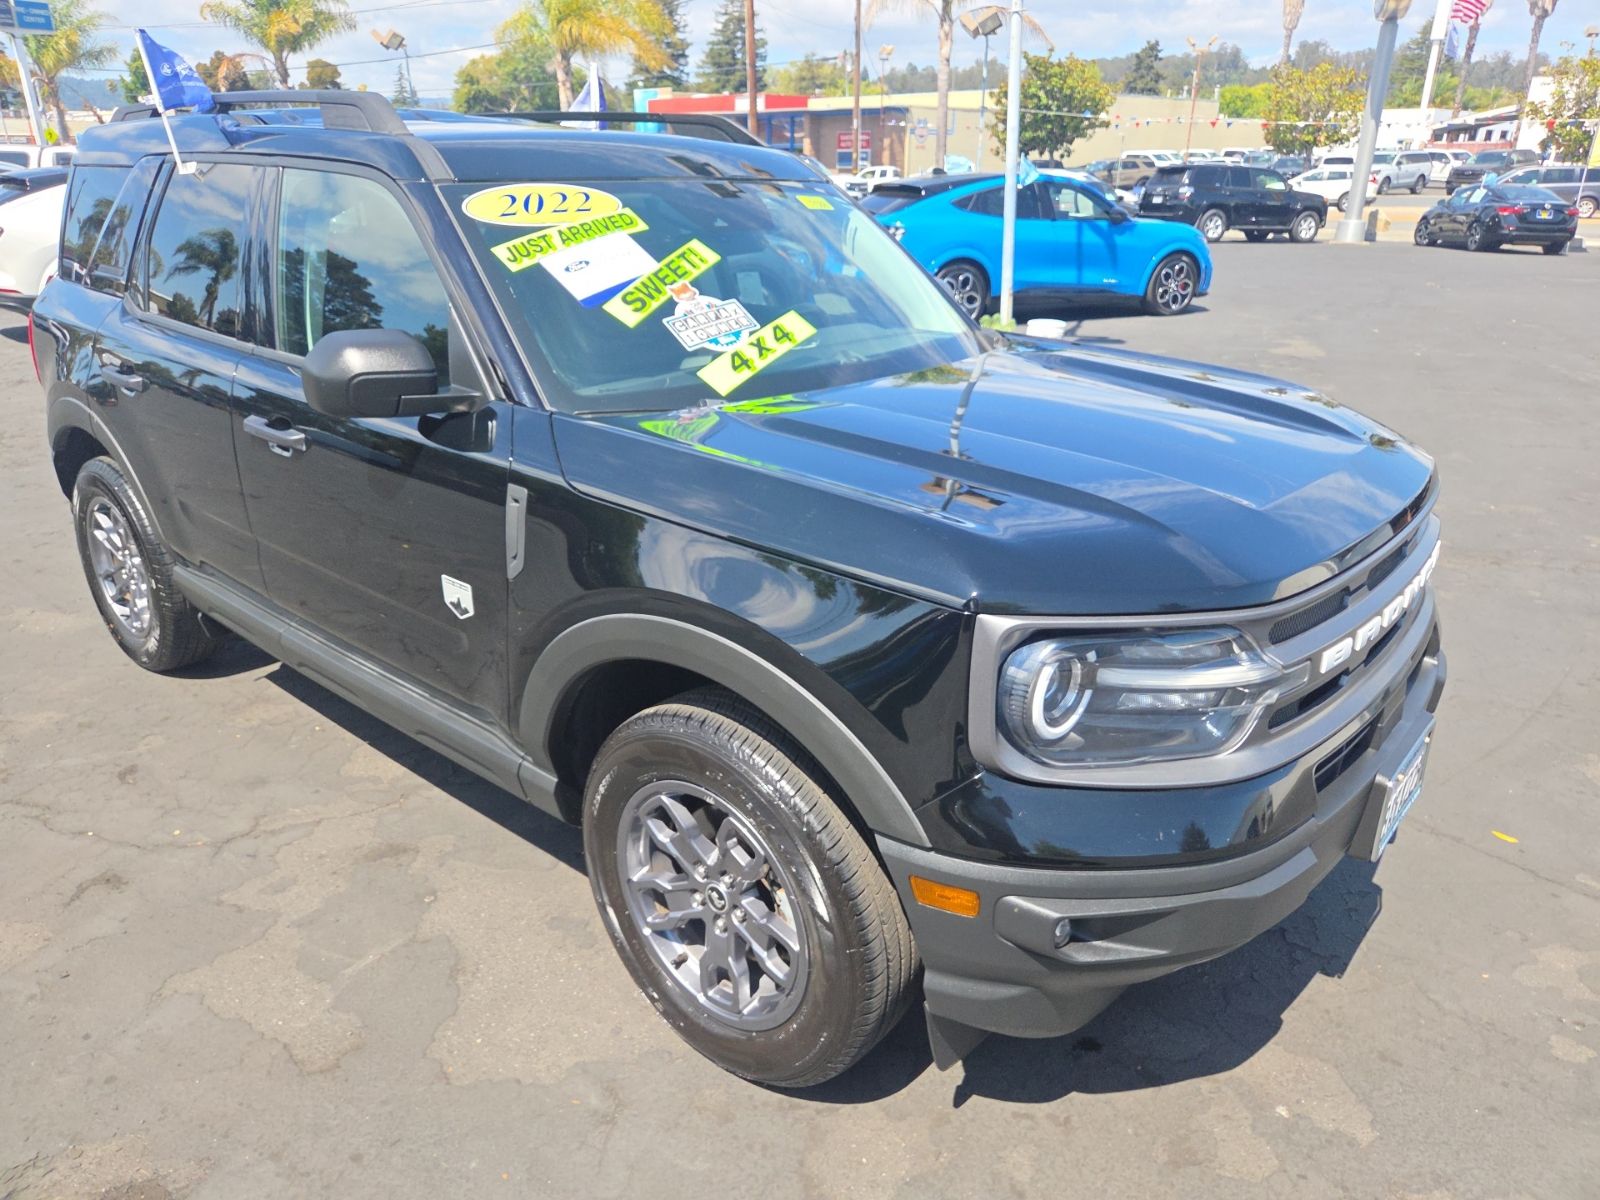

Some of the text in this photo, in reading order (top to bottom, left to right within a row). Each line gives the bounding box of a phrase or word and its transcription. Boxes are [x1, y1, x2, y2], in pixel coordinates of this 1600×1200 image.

[498, 191, 592, 217] 2022
[506, 212, 638, 265] JUST ARRIVED
[620, 246, 709, 313] SWEET!
[672, 305, 743, 333] CARFAX
[695, 316, 752, 341] OWNER
